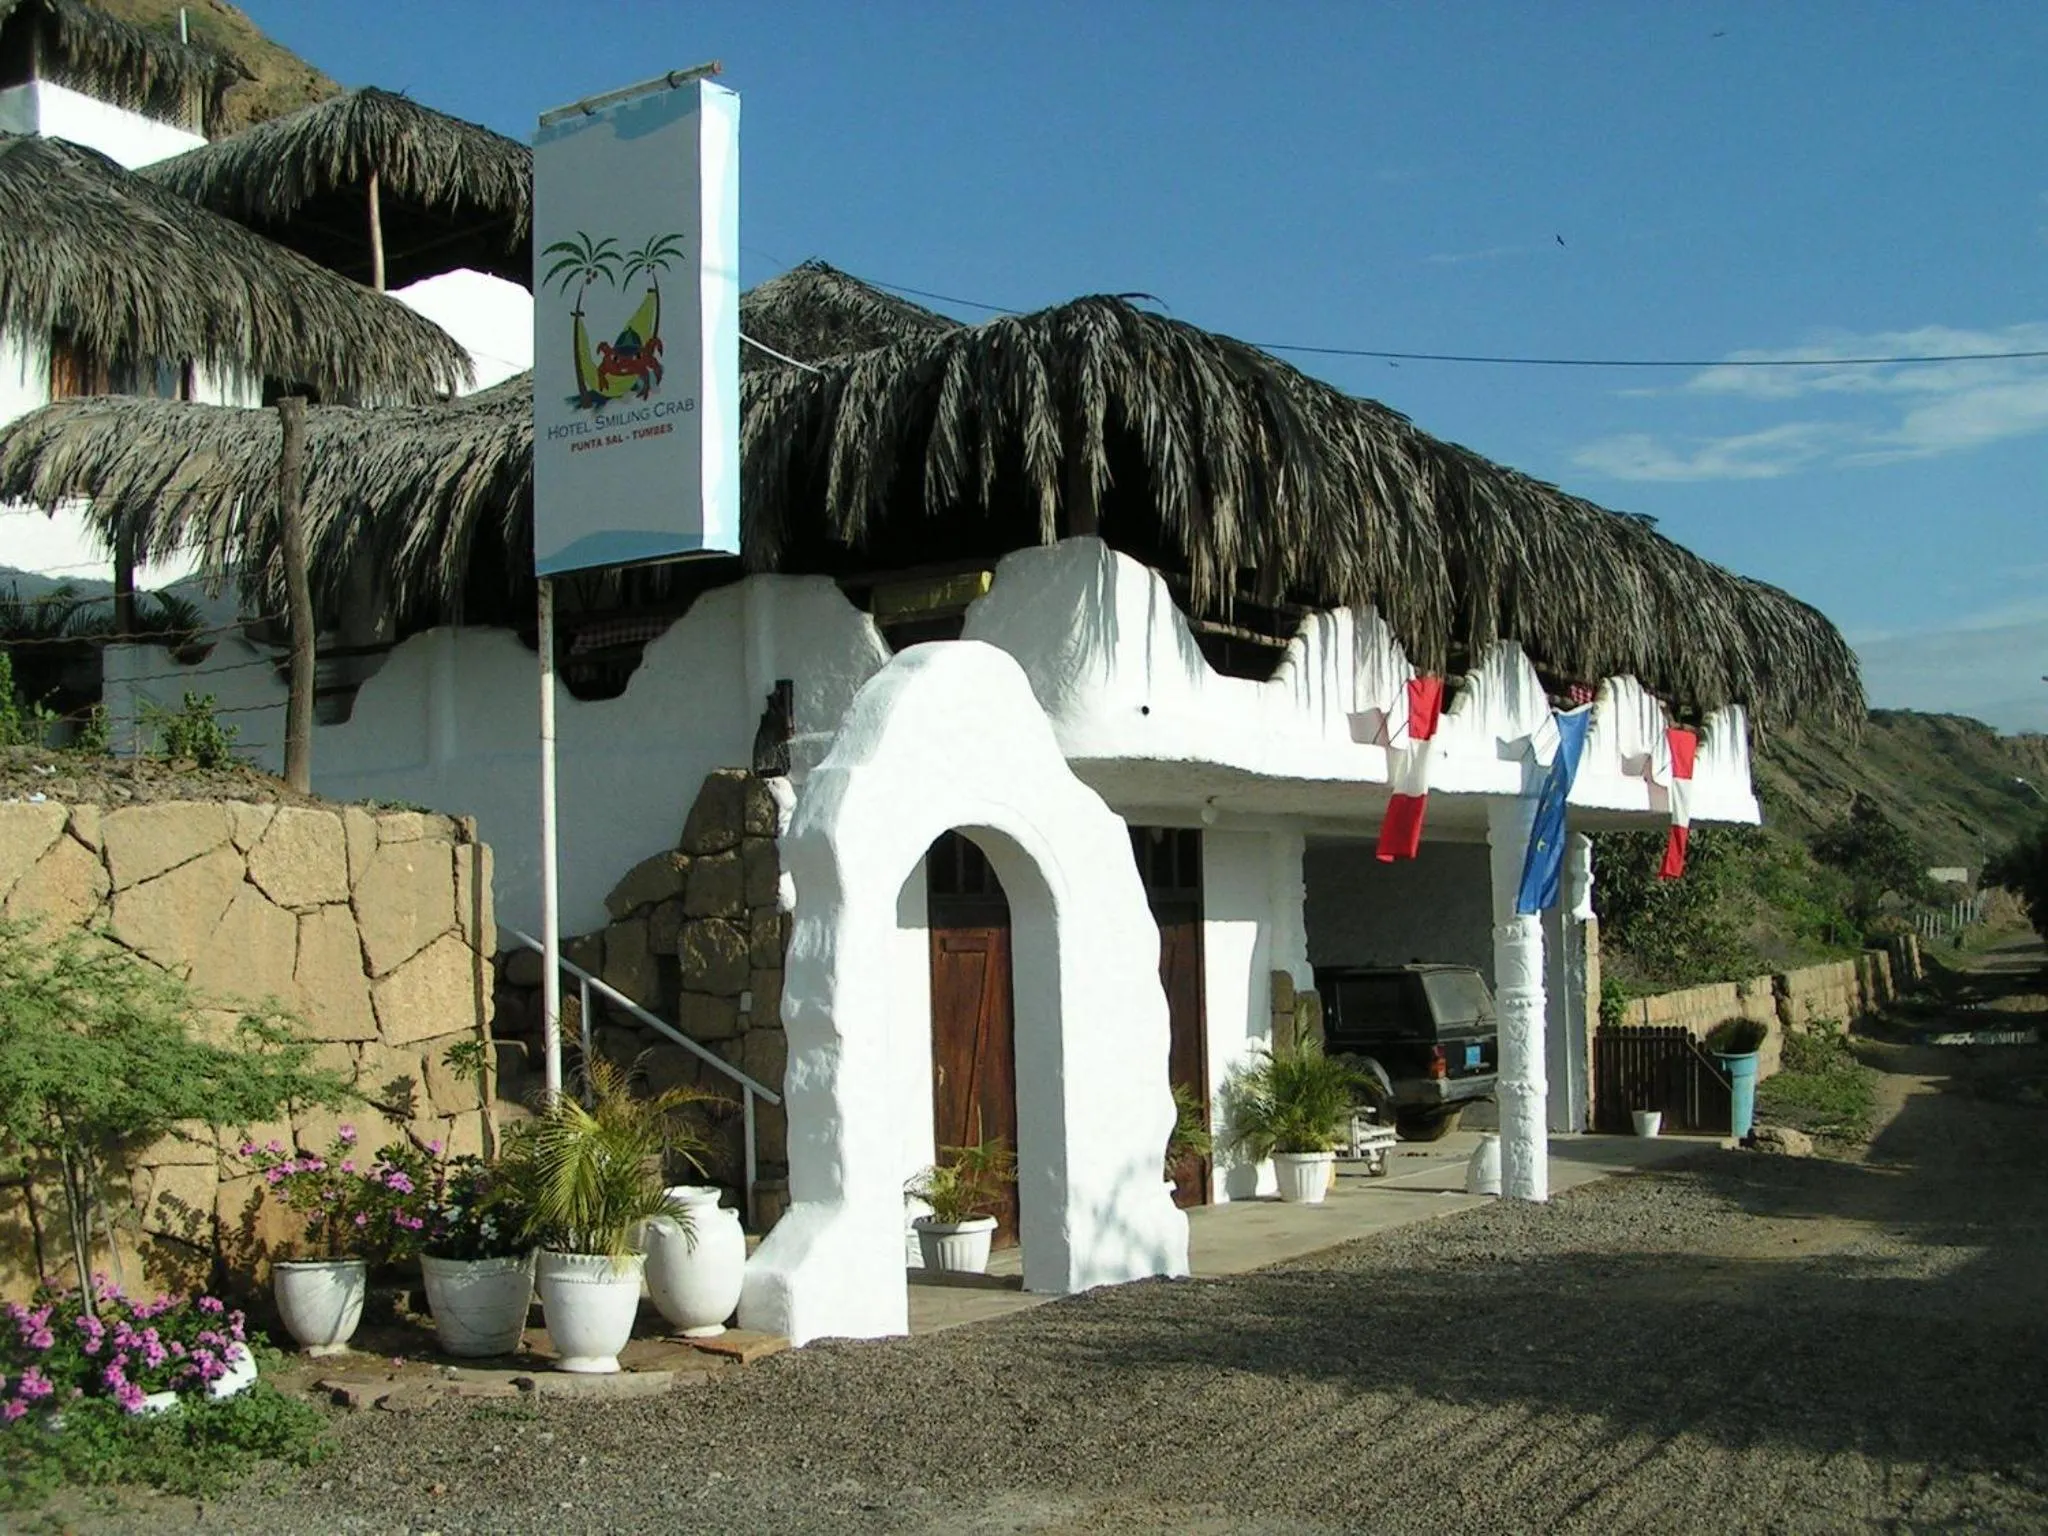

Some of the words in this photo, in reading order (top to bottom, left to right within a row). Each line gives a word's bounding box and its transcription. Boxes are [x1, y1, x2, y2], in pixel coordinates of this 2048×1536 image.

[547, 422, 592, 440] HOTEL
[595, 407, 650, 430] SMILING
[653, 398, 695, 418] CRAB
[570, 439, 603, 453] PUNTA
[605, 435, 624, 447] SAL
[632, 423, 674, 440] TUMBES
